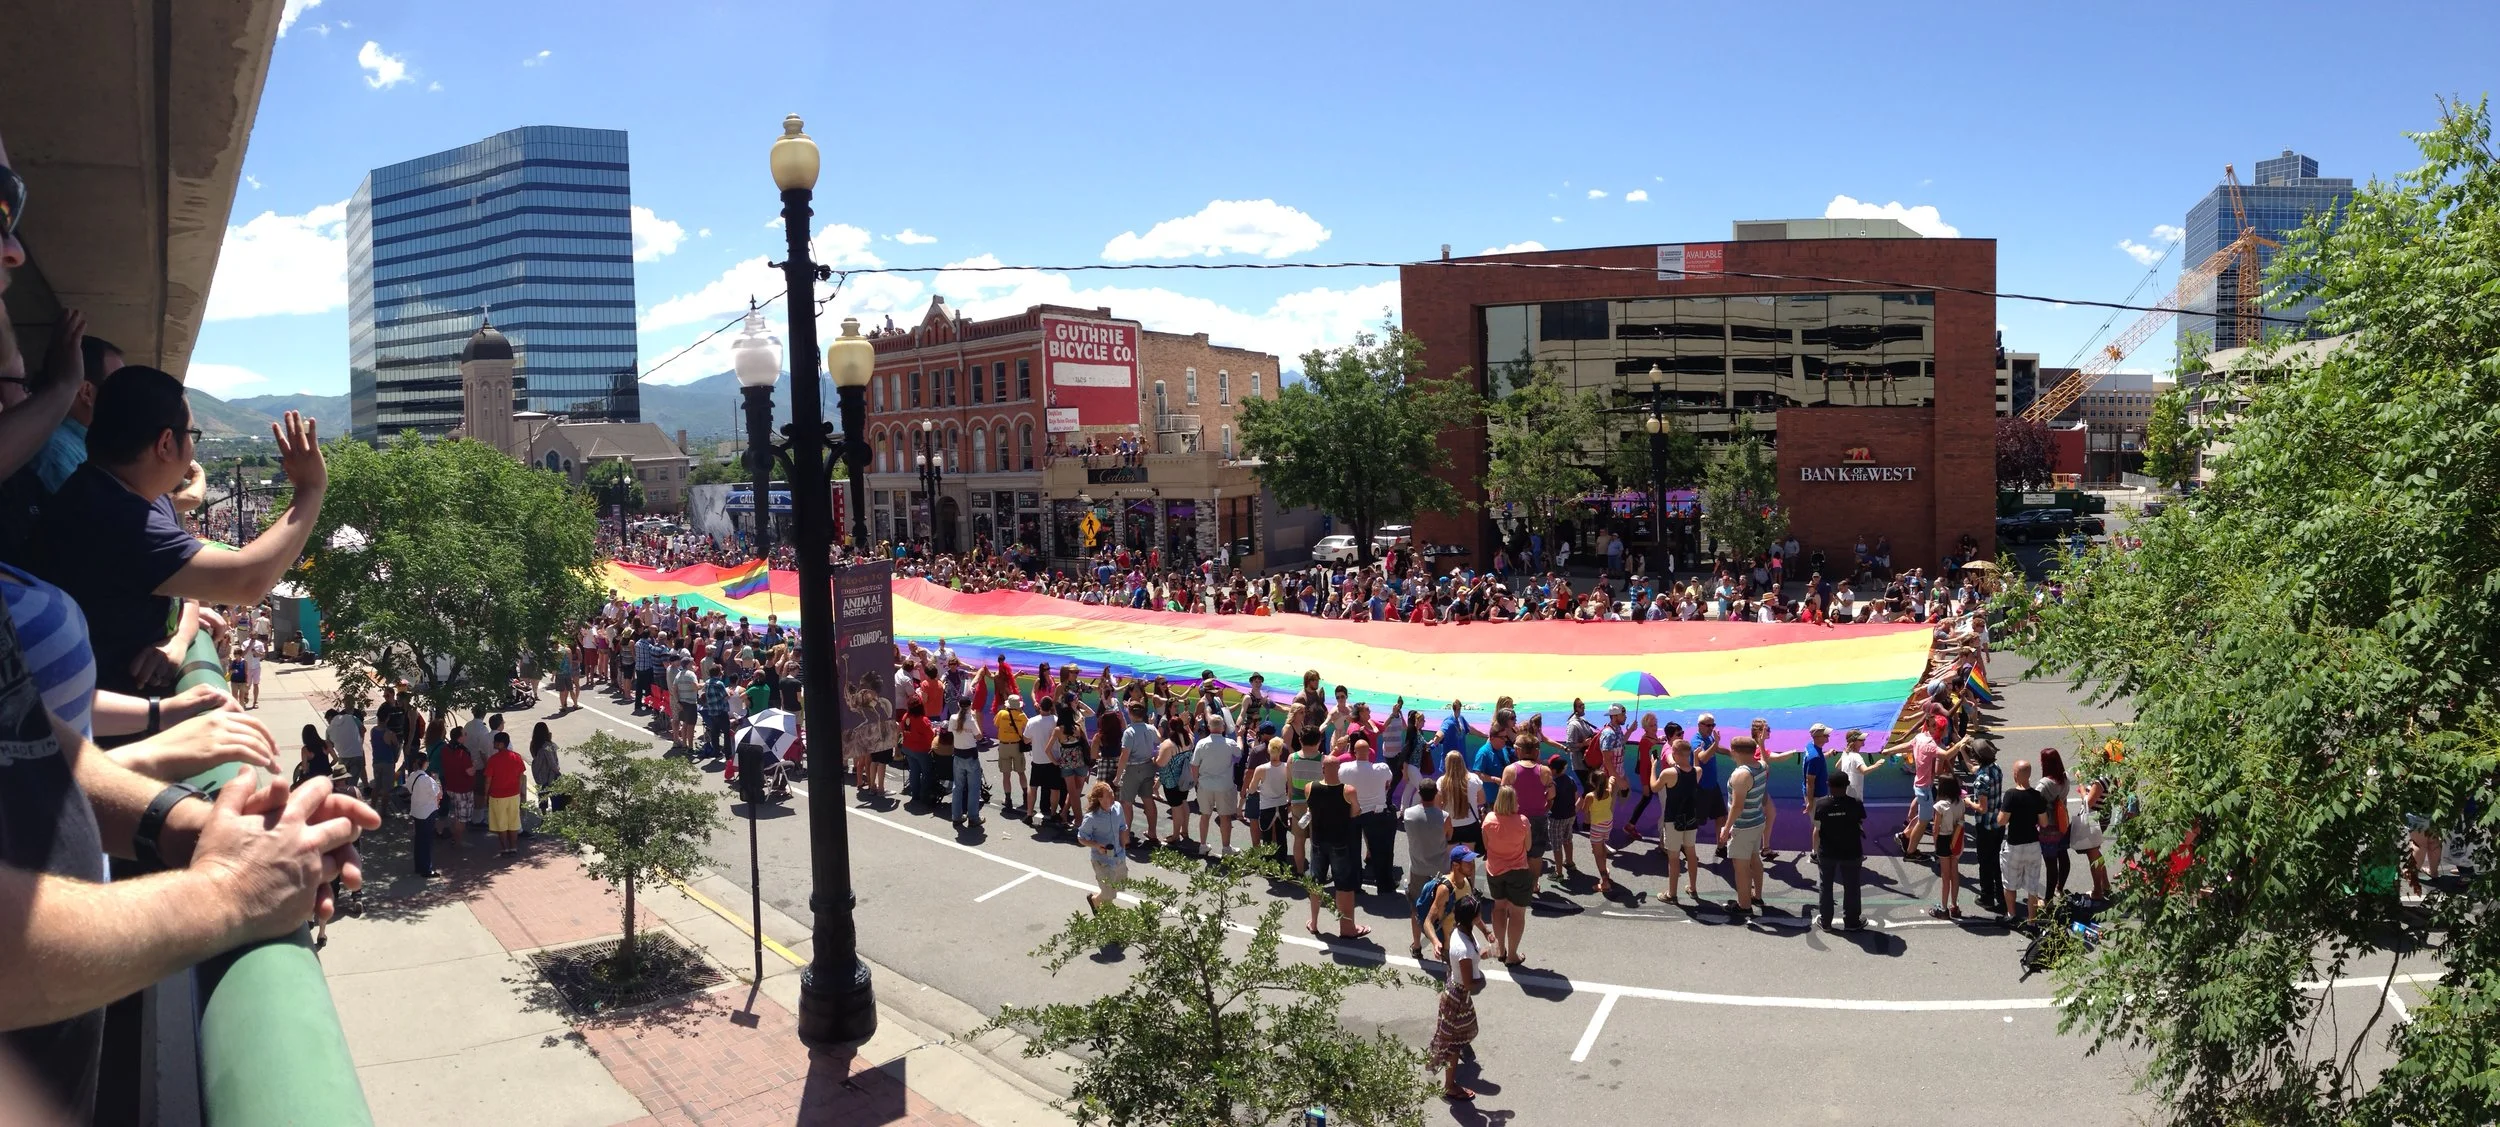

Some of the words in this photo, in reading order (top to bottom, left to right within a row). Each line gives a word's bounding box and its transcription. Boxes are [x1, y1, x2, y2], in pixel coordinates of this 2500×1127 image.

[1686, 249, 1723, 259] AVAILABLE
[1055, 323, 1124, 346] GUTHRIE
[1050, 340, 1108, 361] BICYCLE
[1113, 345, 1135, 362] CO.
[1801, 467, 1851, 481] BANK
[1852, 467, 1864, 475] OF
[1866, 467, 1916, 481] WEST
[842, 595, 882, 610] ANIMAL
[843, 607, 867, 618] INSIDE
[868, 604, 883, 614] OUT
